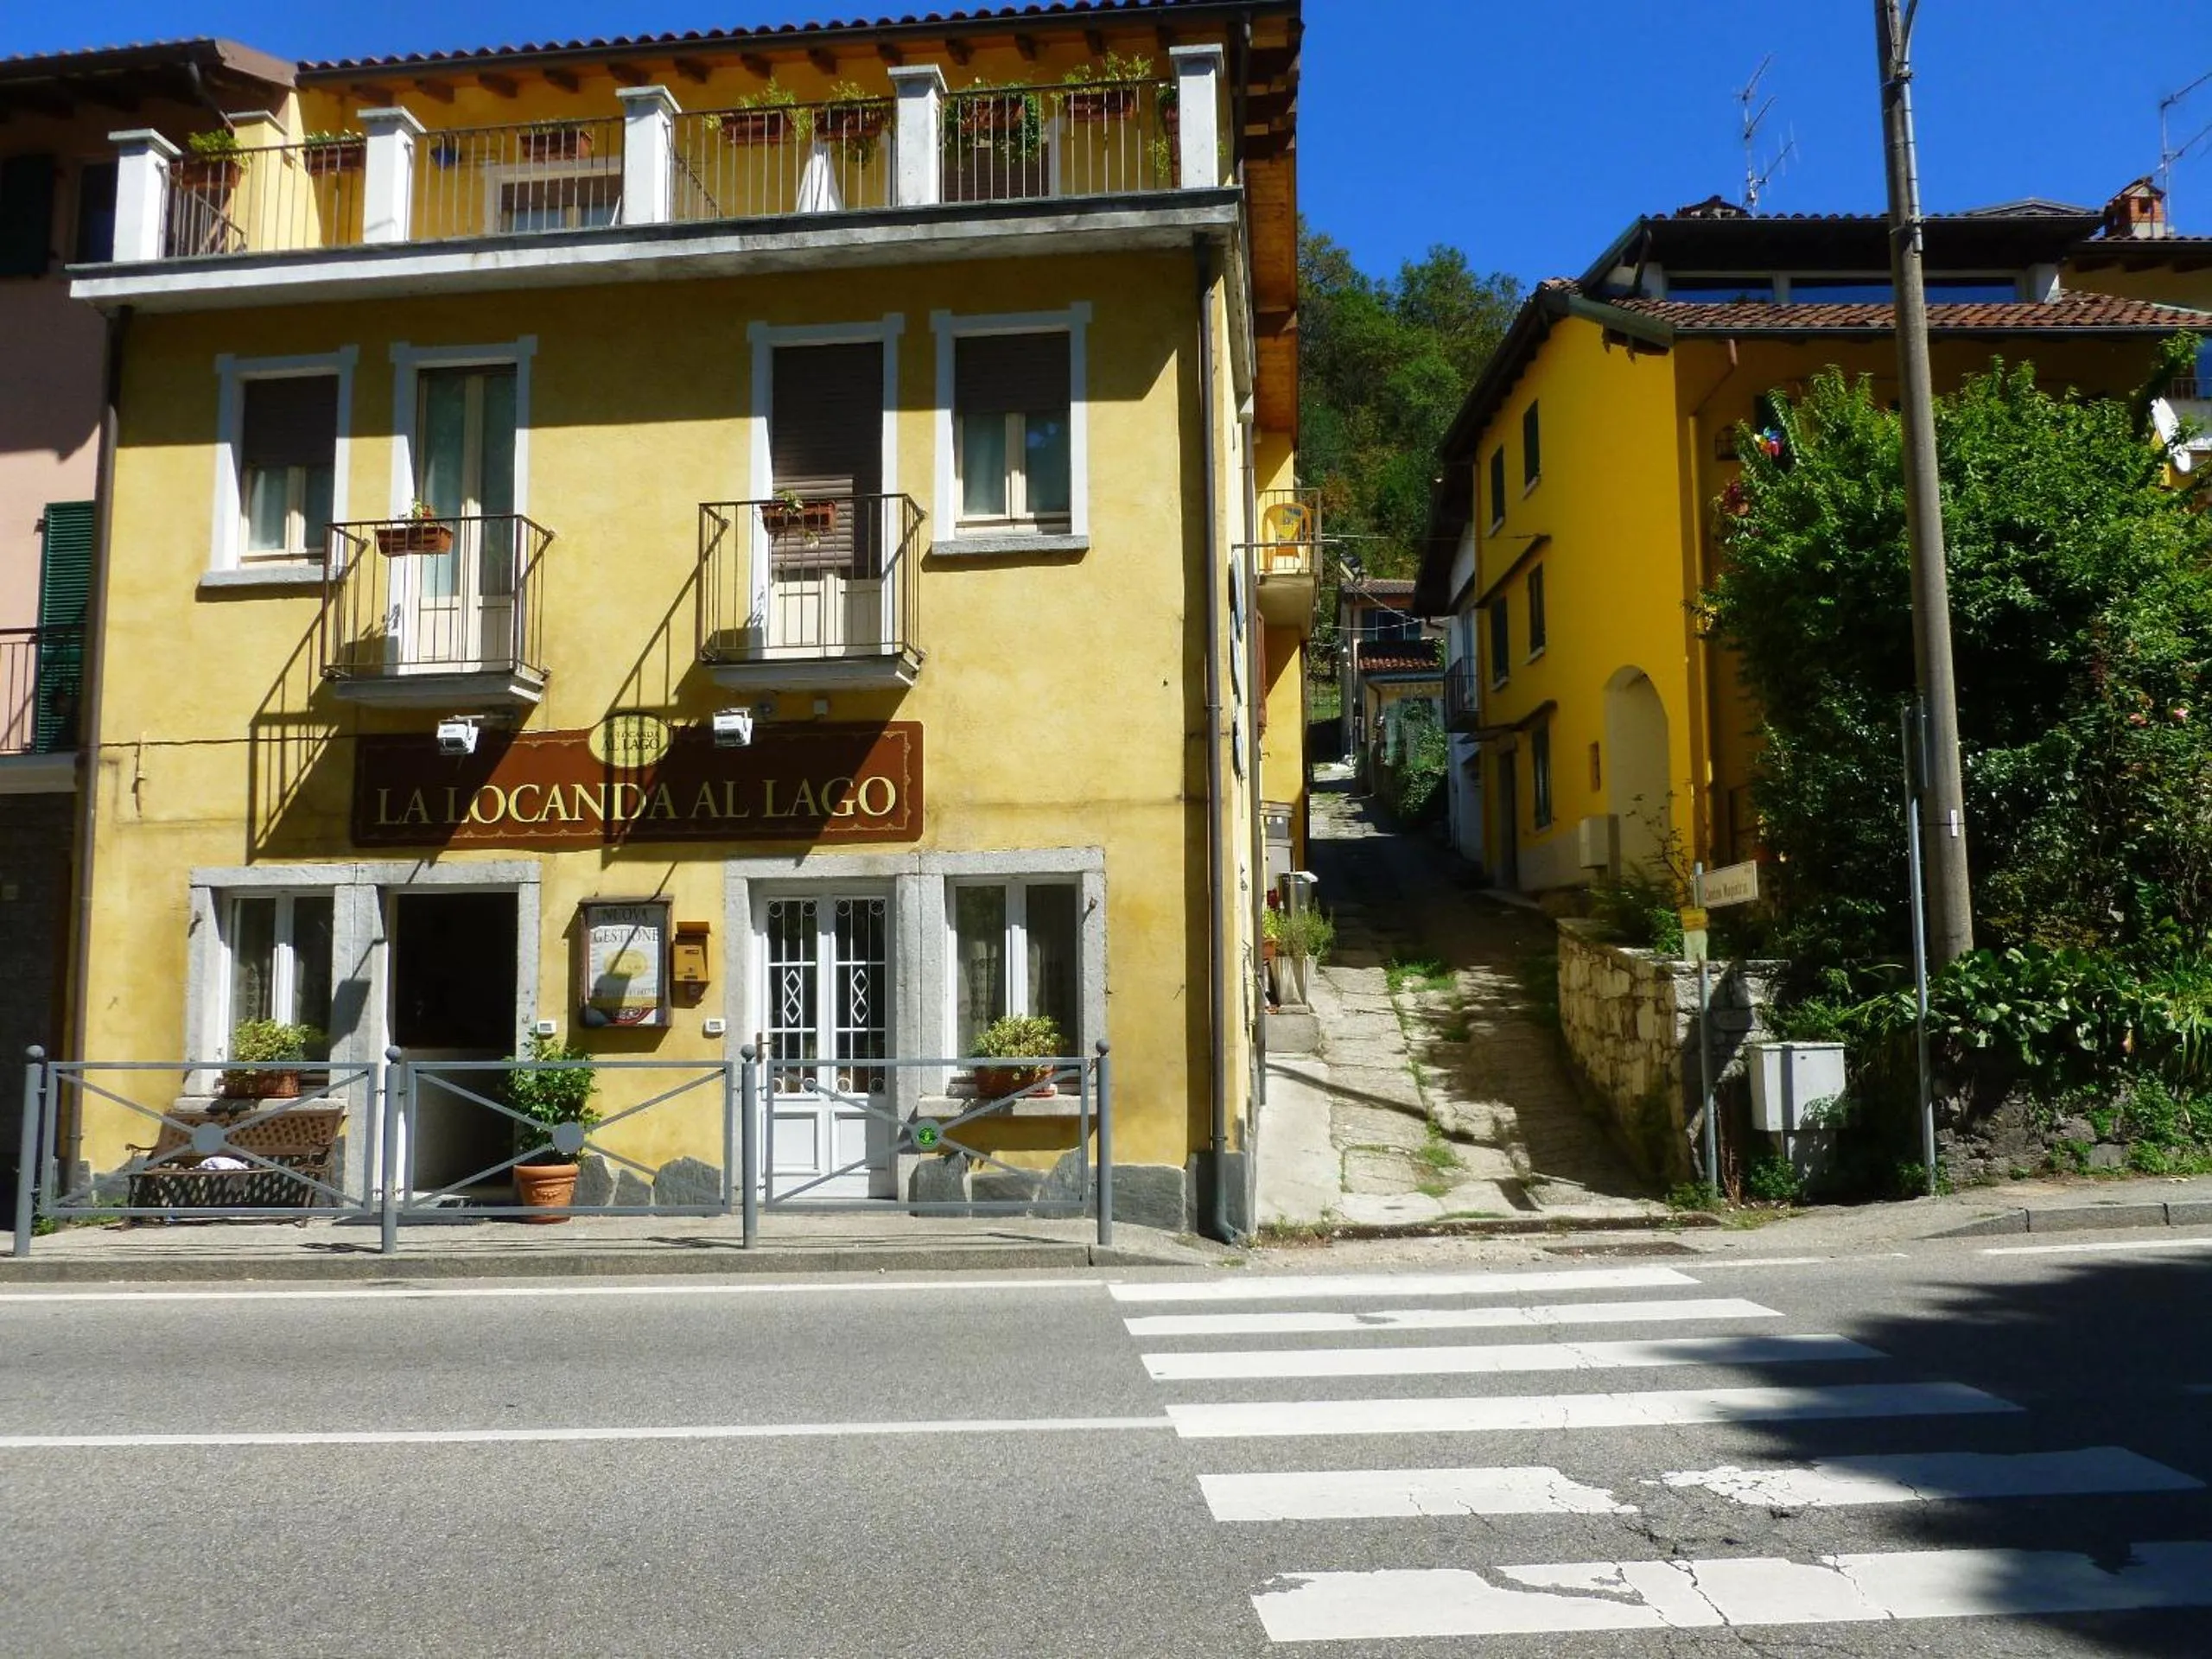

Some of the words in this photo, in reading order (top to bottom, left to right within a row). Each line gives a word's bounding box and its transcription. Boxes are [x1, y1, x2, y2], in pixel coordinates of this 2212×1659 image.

[601, 739, 620, 752] AL
[623, 738, 660, 751] LAGO
[377, 786, 432, 824] LA
[444, 781, 678, 824] LOCANDA
[691, 780, 750, 818] AL
[763, 776, 896, 818] LAGO
[594, 928, 659, 944] GESTIONE
